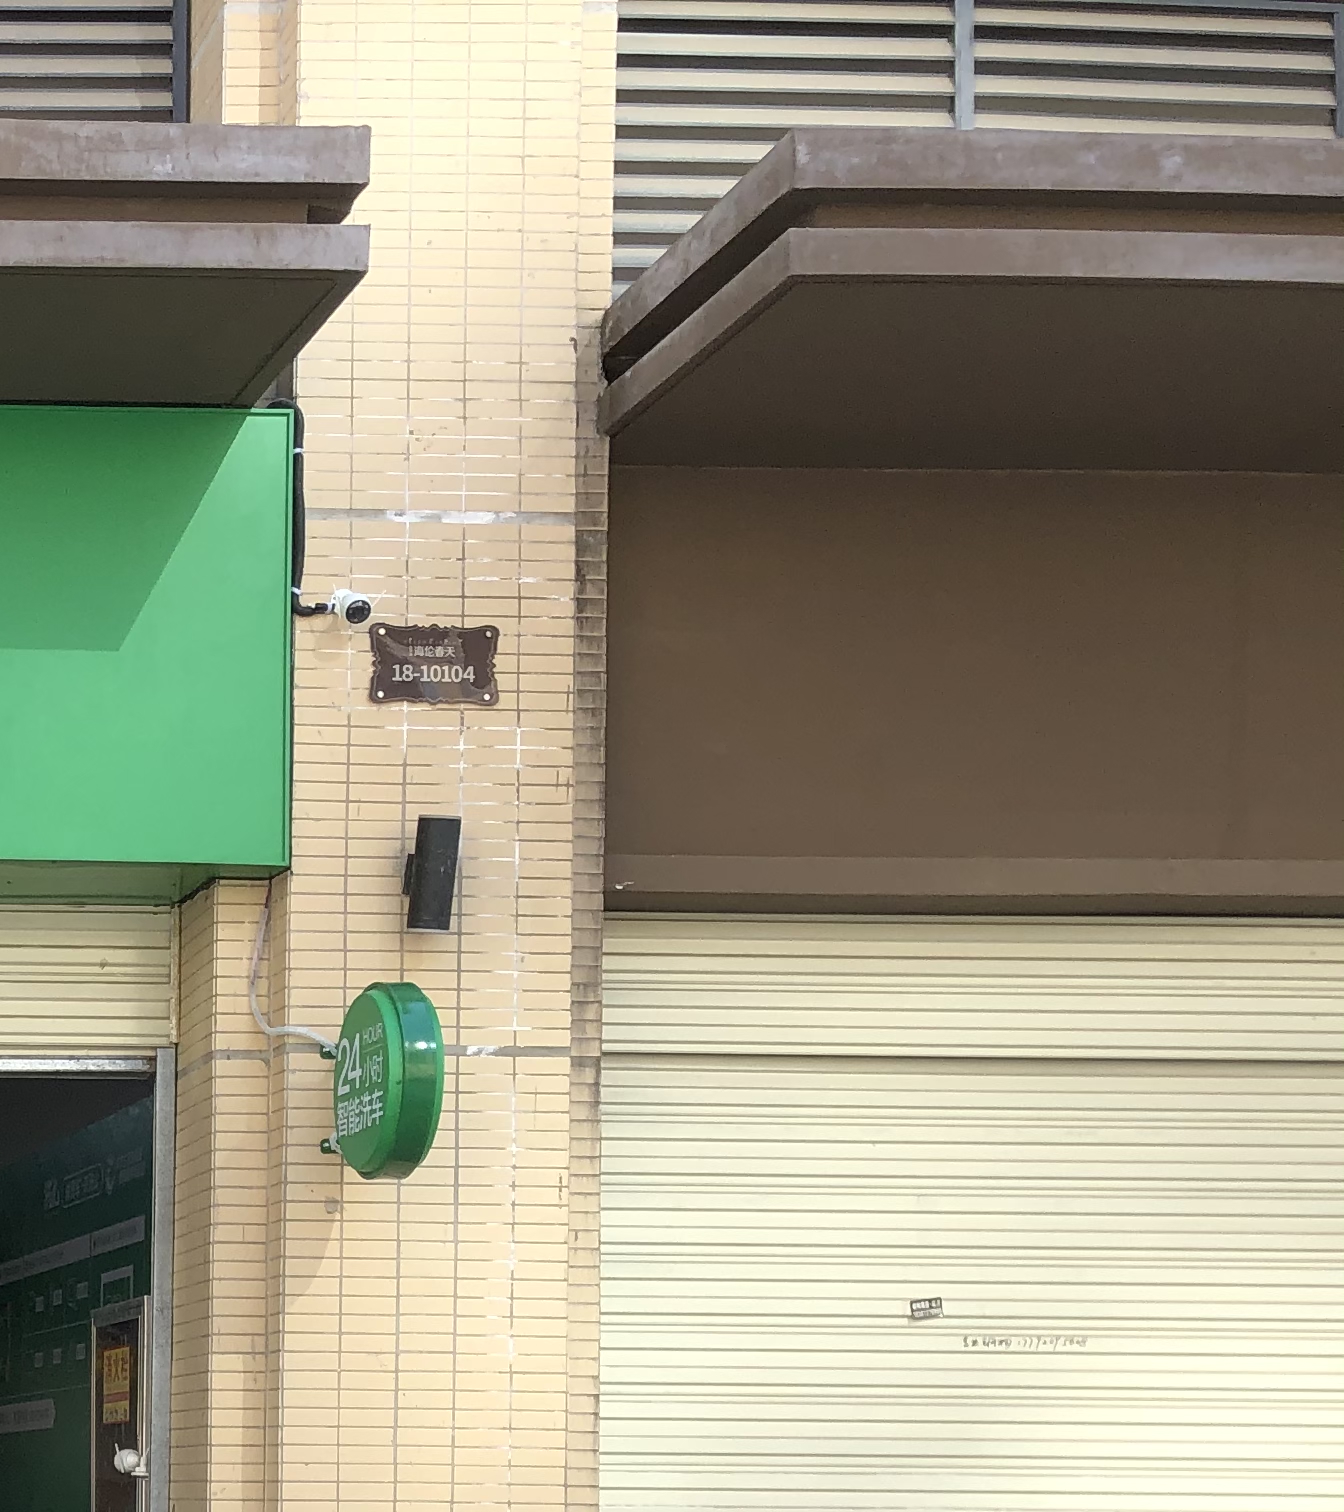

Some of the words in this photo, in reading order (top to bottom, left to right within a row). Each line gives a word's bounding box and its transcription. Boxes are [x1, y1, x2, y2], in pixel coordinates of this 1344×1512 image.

[391, 664, 476, 683] 18-10104
[362, 1022, 384, 1045] HOUR
[337, 1032, 363, 1097] 24
[362, 1049, 384, 1088] 小时
[336, 1088, 384, 1138] 智能洗车
